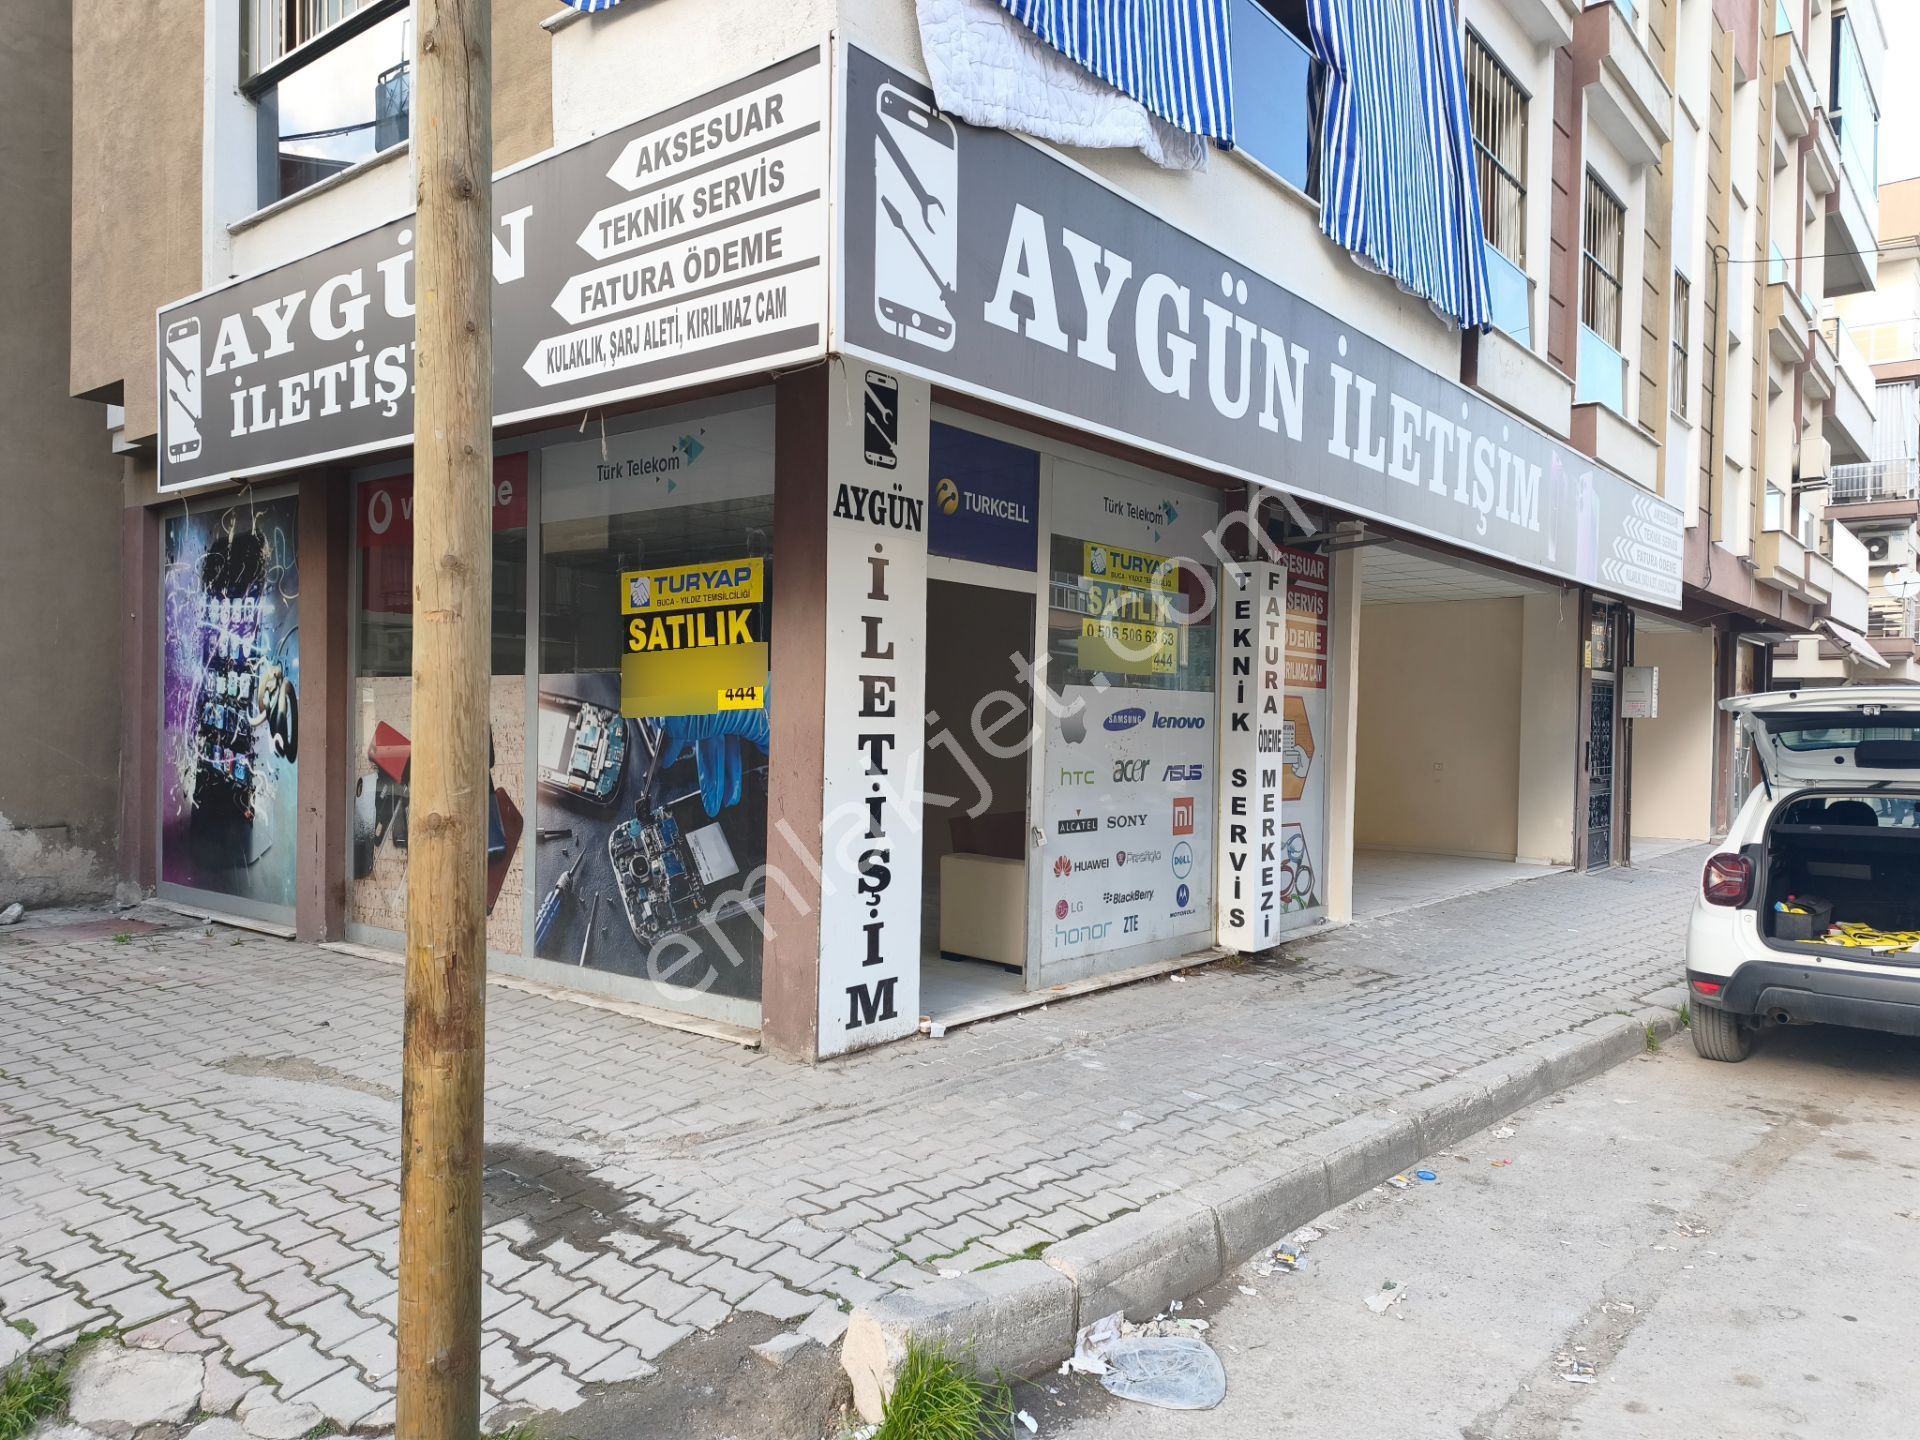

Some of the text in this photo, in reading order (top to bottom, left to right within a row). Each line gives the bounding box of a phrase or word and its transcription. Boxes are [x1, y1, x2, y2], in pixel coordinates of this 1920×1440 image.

[636, 93, 784, 178] AKSESUAR
[599, 157, 785, 249] TEKNİK SERVİS
[580, 226, 783, 314] FATURA ÖDEME
[546, 286, 787, 375] KULAKLIK, ŞARJ ALETİ, KIRILMAZ CAM
[984, 202, 1544, 536] AYGÜN İLETİŞİM
[230, 339, 416, 437] İLETİŞ
[596, 454, 680, 481] Türk Telekom
[833, 483, 923, 532] AYGÜN
[964, 491, 1029, 524] TURKCELL
[1103, 497, 1163, 526] Türk Telekom
[1110, 553, 1172, 575] TURYAP
[655, 566, 751, 594] TURYAP
[656, 598, 674, 607] BUCA
[680, 595, 701, 605] YILDIZ
[1087, 586, 1172, 625] SATILIK
[1287, 592, 1324, 615] SERVİS
[629, 609, 753, 652] SATILIK
[1087, 624, 1094, 637] 0
[1098, 626, 1119, 640] 506
[1121, 627, 1142, 642] 506
[1285, 628, 1322, 649] DEME
[1154, 654, 1172, 668] 444
[725, 686, 756, 701] 444
[1108, 714, 1141, 724] SAMSUNG
[1152, 711, 1205, 729] lenovo
[1229, 572, 1252, 927] TEKNİK SERVİS
[1258, 571, 1281, 937] FATURA ÖDEME MERKEZİ
[1061, 768, 1094, 785] htc
[1113, 759, 1150, 782] acer
[1162, 764, 1203, 782] ASUS
[845, 543, 898, 1030] İLETİŞİM
[1059, 820, 1097, 833] ALCATEL
[1107, 814, 1147, 828] SONY
[1074, 858, 1109, 872] HUAWEI
[1174, 855, 1191, 865] DELL
[1071, 902, 1083, 913] LG
[1113, 889, 1154, 905] BlackBerry
[1123, 915, 1138, 933] ZTE
[1169, 908, 1196, 918] MOTOROLA
[1055, 921, 1113, 947] honor
